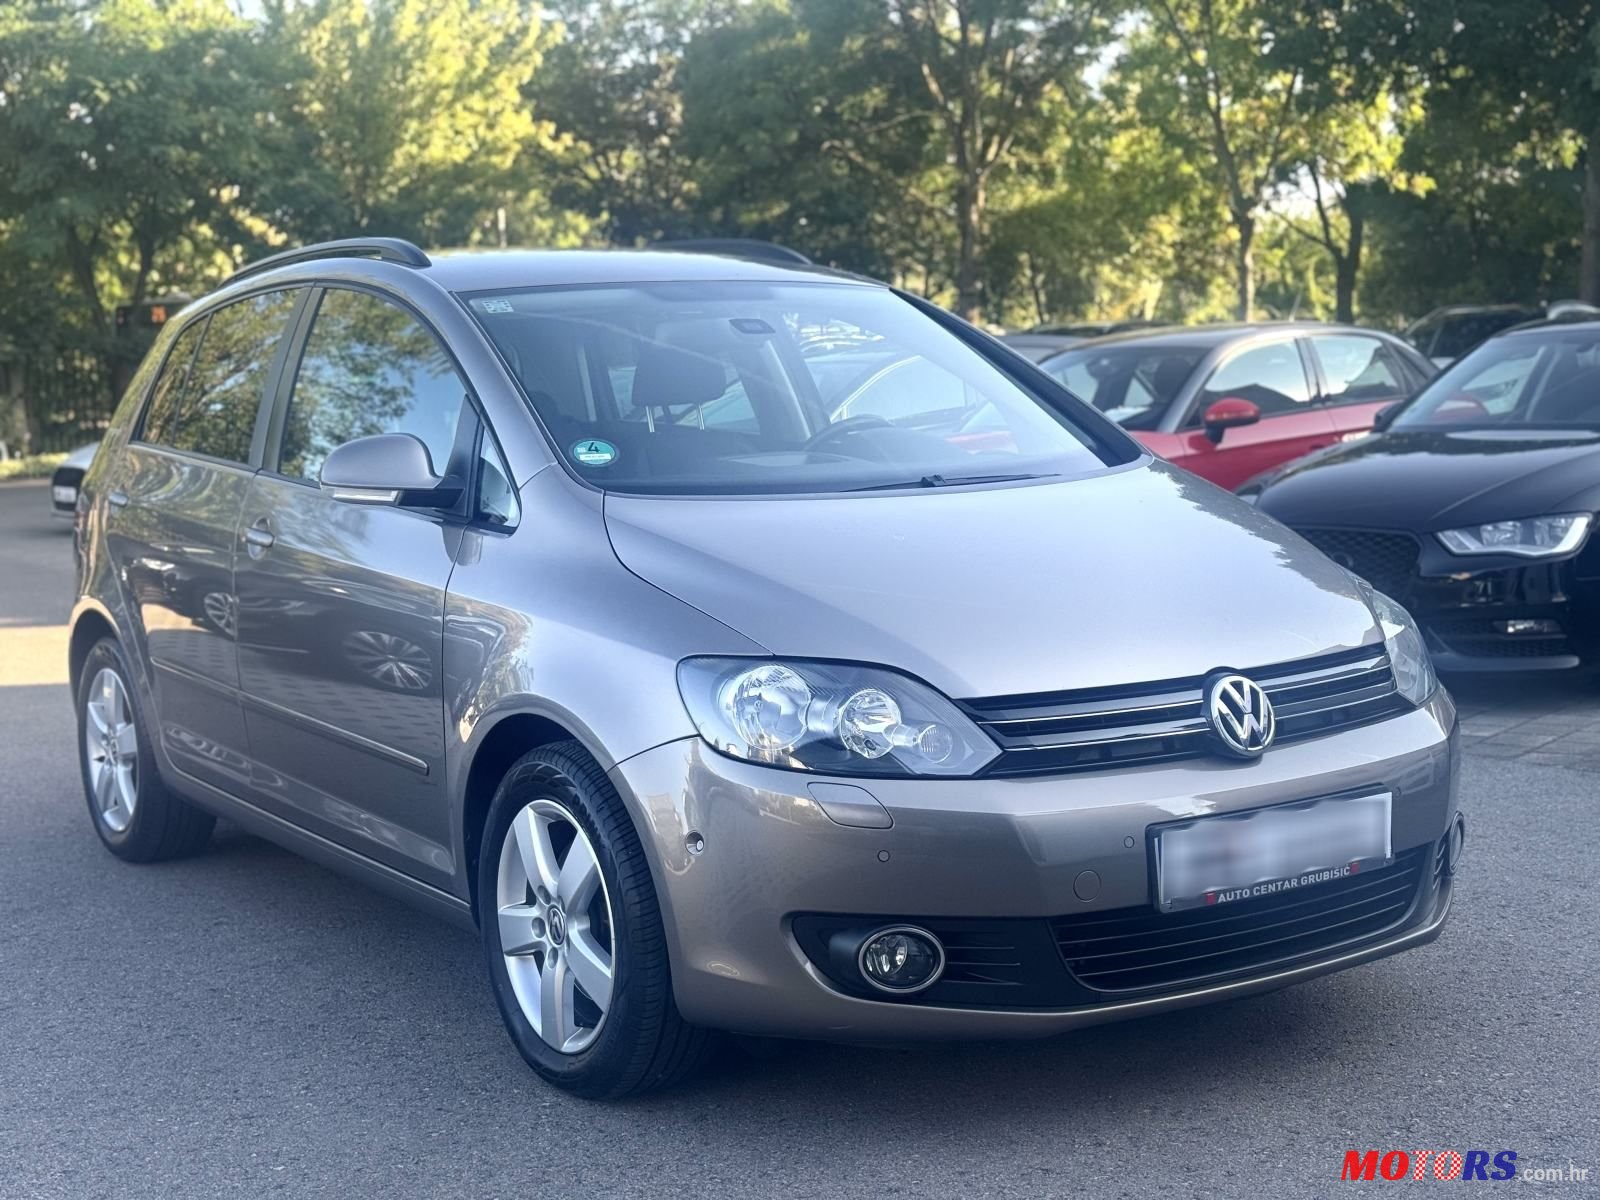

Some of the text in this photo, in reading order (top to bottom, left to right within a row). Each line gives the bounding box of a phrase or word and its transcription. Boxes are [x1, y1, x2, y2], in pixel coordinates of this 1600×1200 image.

[587, 442, 601, 452] 4
[1212, 676, 1273, 752] VW
[1217, 888, 1250, 904] AUTO
[1253, 879, 1298, 896] CENTAR
